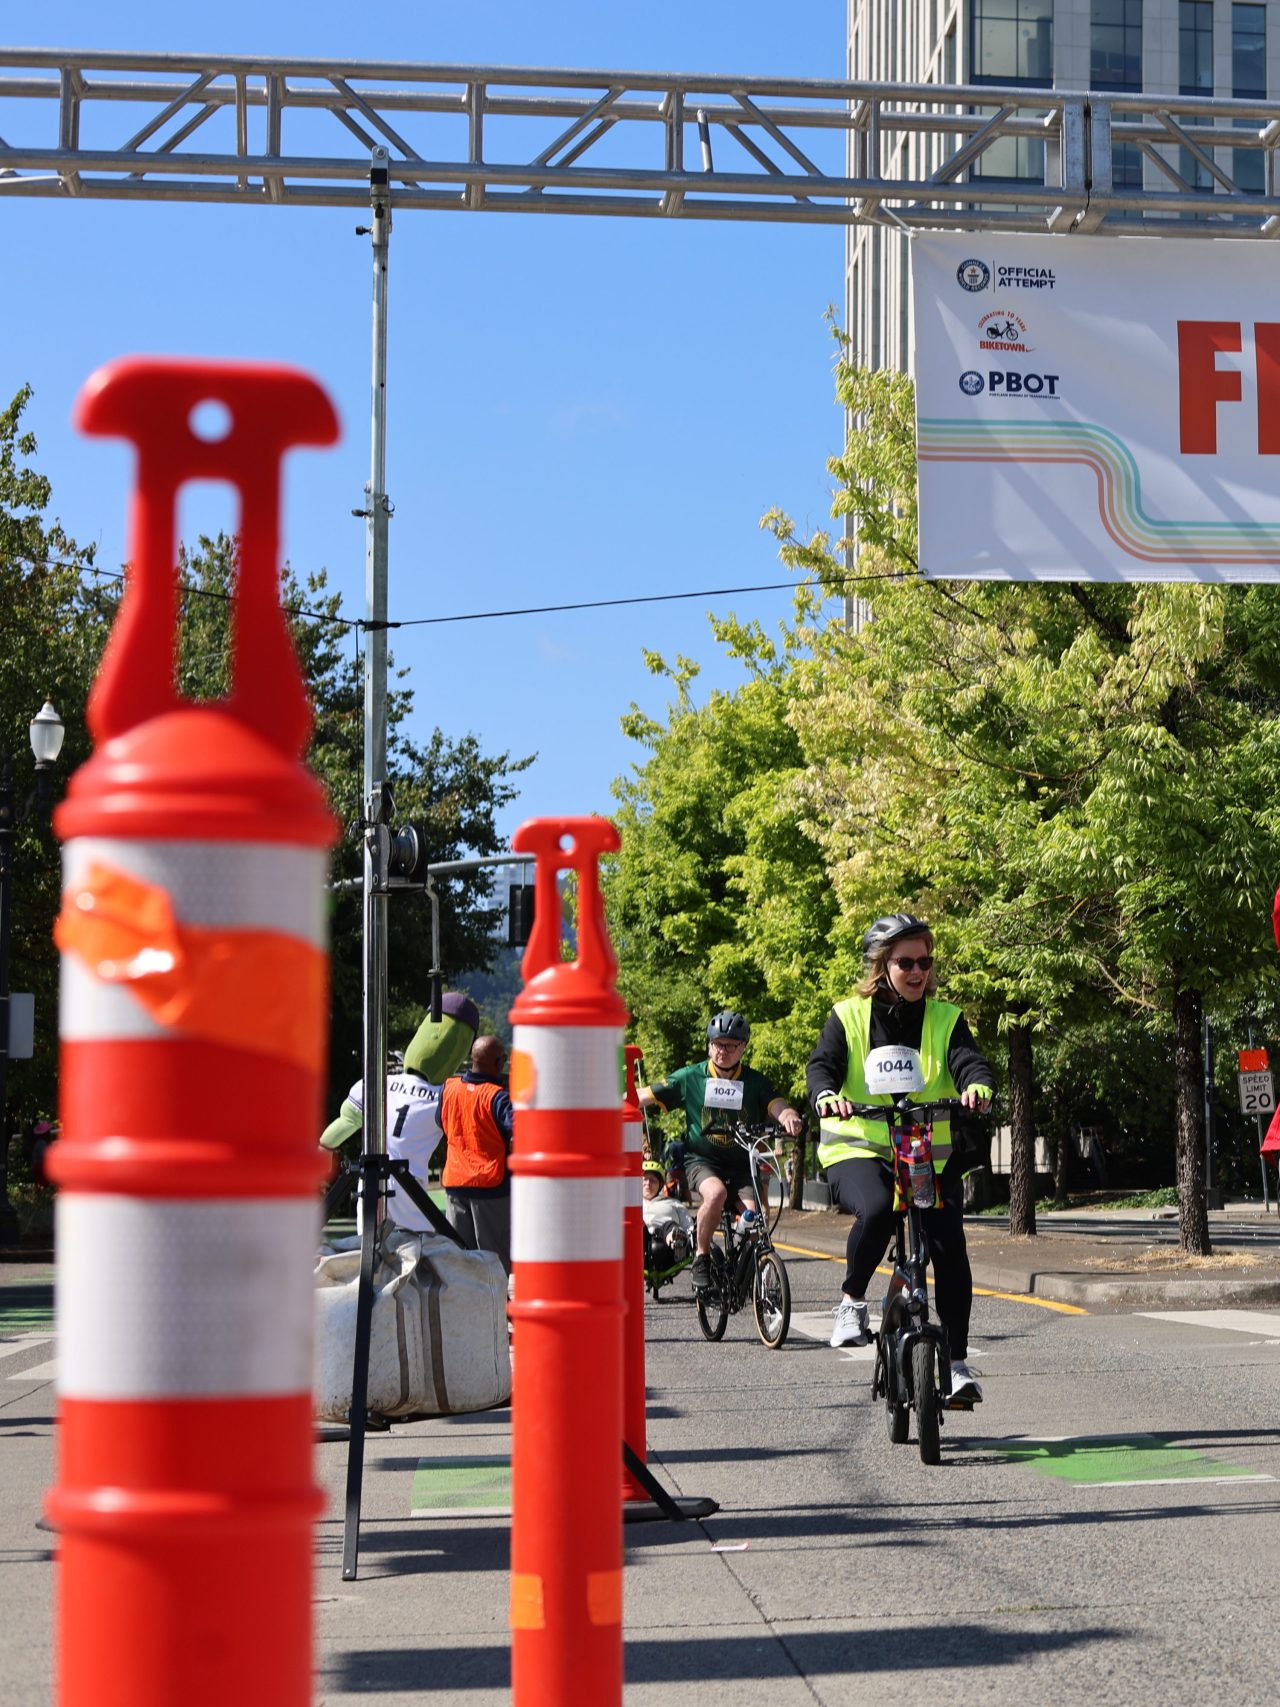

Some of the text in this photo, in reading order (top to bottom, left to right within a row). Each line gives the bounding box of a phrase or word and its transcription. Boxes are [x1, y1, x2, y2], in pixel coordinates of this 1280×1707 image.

[997, 266, 1056, 279] OFFICIAL
[998, 277, 1056, 289] ATTEMPT
[979, 340, 1026, 352] BIKETOWN
[988, 371, 1060, 395] PBOT
[876, 1059, 914, 1073] 1044
[1242, 1075, 1270, 1084] SPEED
[713, 1087, 736, 1097] 1047
[1246, 1084, 1267, 1093] LIMIT
[1245, 1093, 1271, 1110] 20
[392, 1104, 410, 1138] 1
